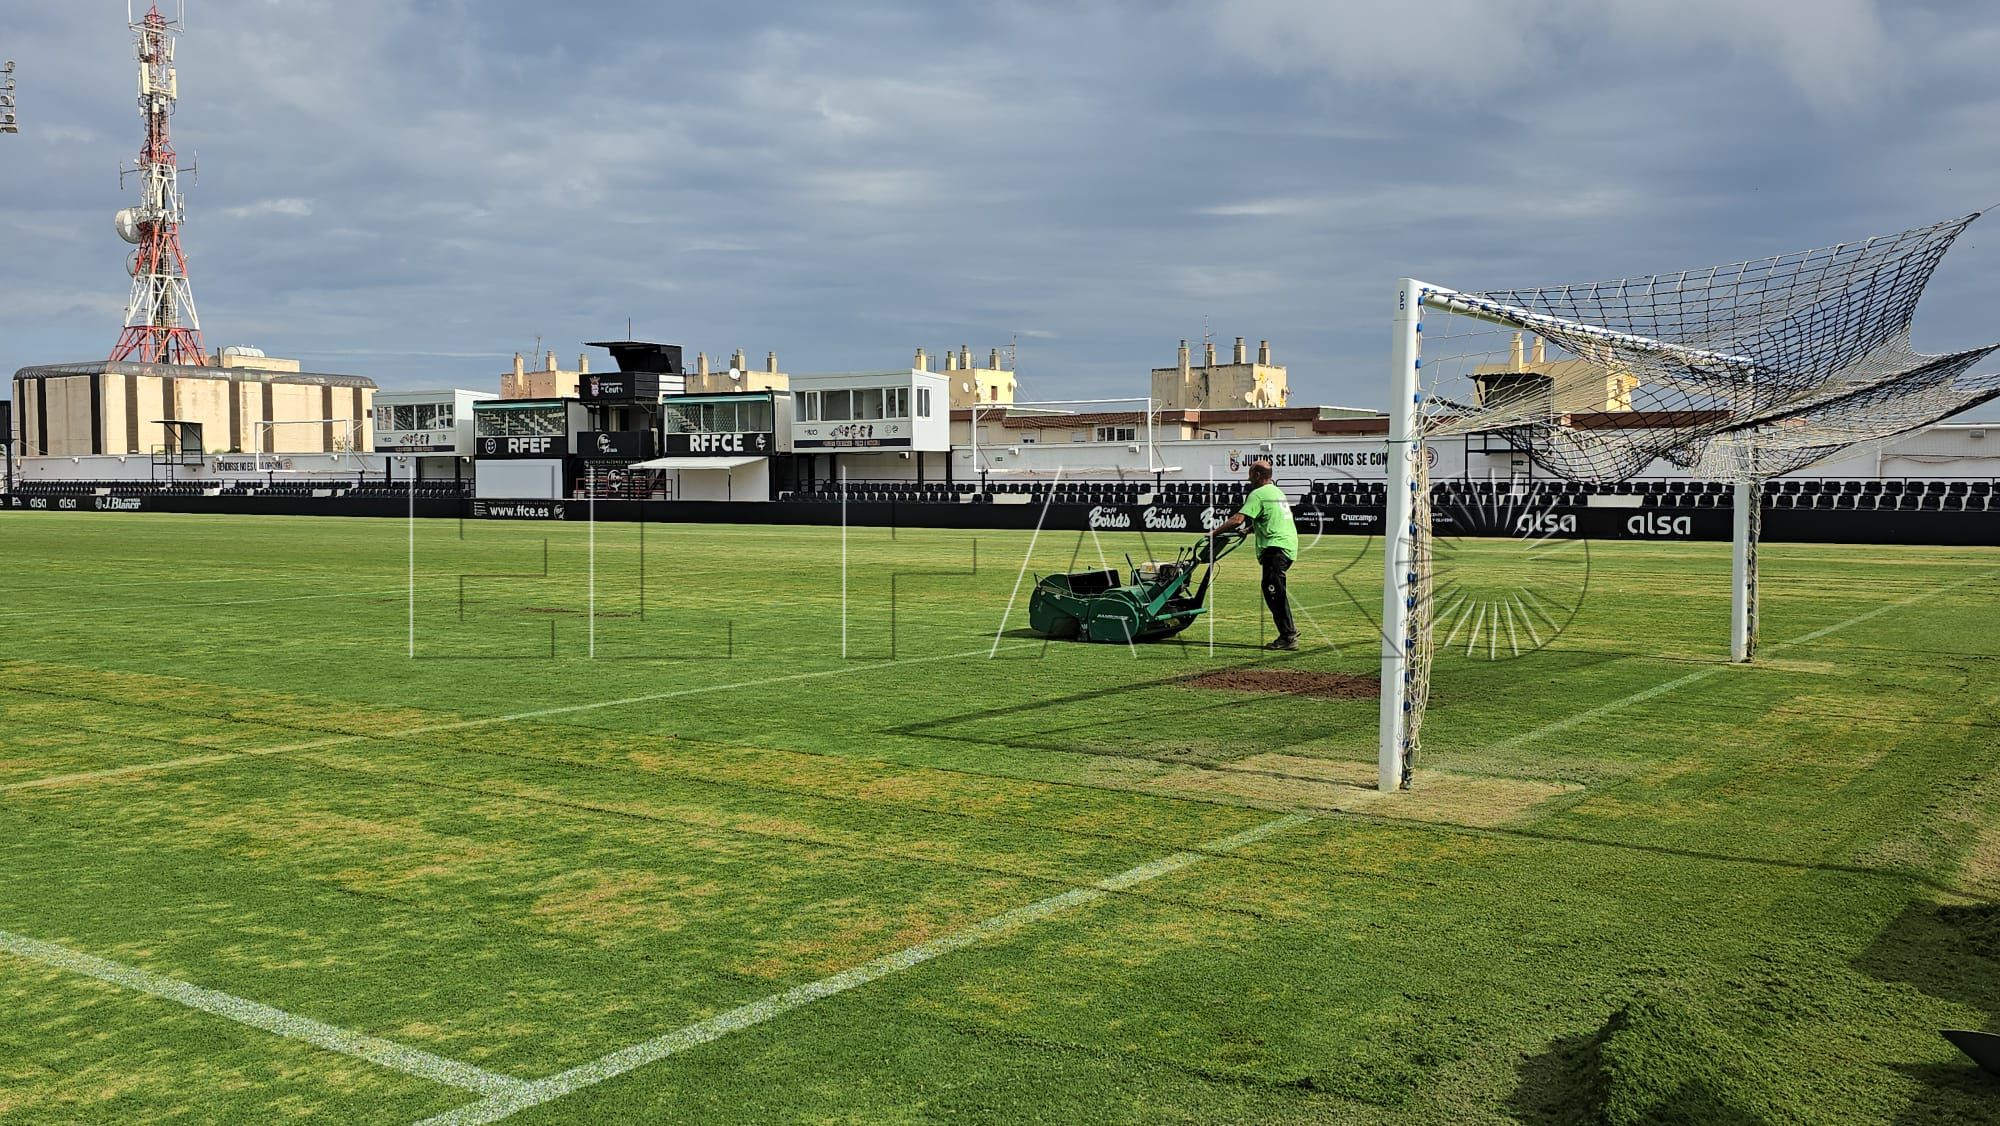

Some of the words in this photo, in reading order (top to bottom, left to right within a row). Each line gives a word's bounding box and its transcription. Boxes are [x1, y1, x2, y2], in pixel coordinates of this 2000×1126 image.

[507, 437, 552, 454] RFEF
[689, 434, 744, 452] RFFCE
[1275, 454, 1287, 467] SE
[1288, 453, 1319, 468] LUCHA,
[1320, 452, 1355, 467] JUNTOS
[1356, 452, 1368, 466] SE
[30, 496, 47, 509] alsa
[59, 496, 77, 509] alsa
[489, 504, 550, 517] www.ffce.es
[1340, 513, 1378, 522] Cruzcampo
[1516, 510, 1577, 533] alsa
[1627, 511, 1692, 536] alsa
